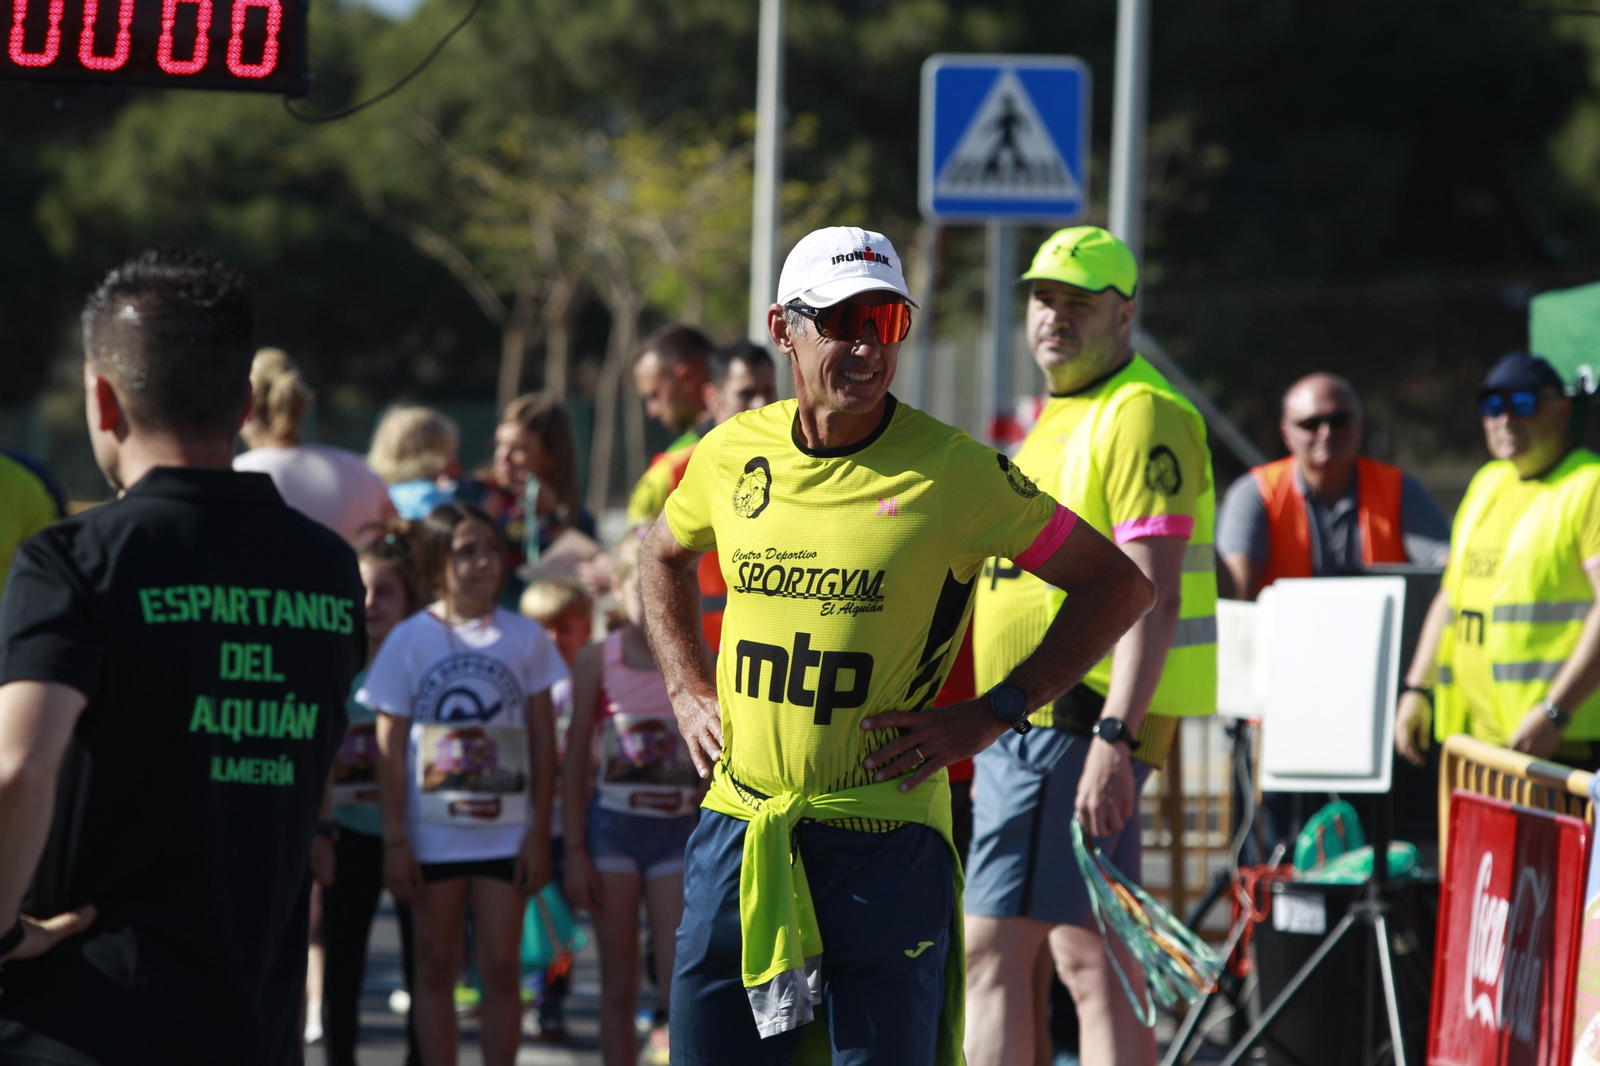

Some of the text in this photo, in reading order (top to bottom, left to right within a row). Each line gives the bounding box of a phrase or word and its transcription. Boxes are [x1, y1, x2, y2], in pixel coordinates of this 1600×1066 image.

[732, 547, 817, 563] Centro Deportivo
[736, 561, 885, 601] SPORTGYM
[138, 584, 354, 635] ESPARTANOS
[820, 600, 883, 617] El Alquián
[219, 641, 286, 682] DEL
[735, 632, 874, 725] mtp
